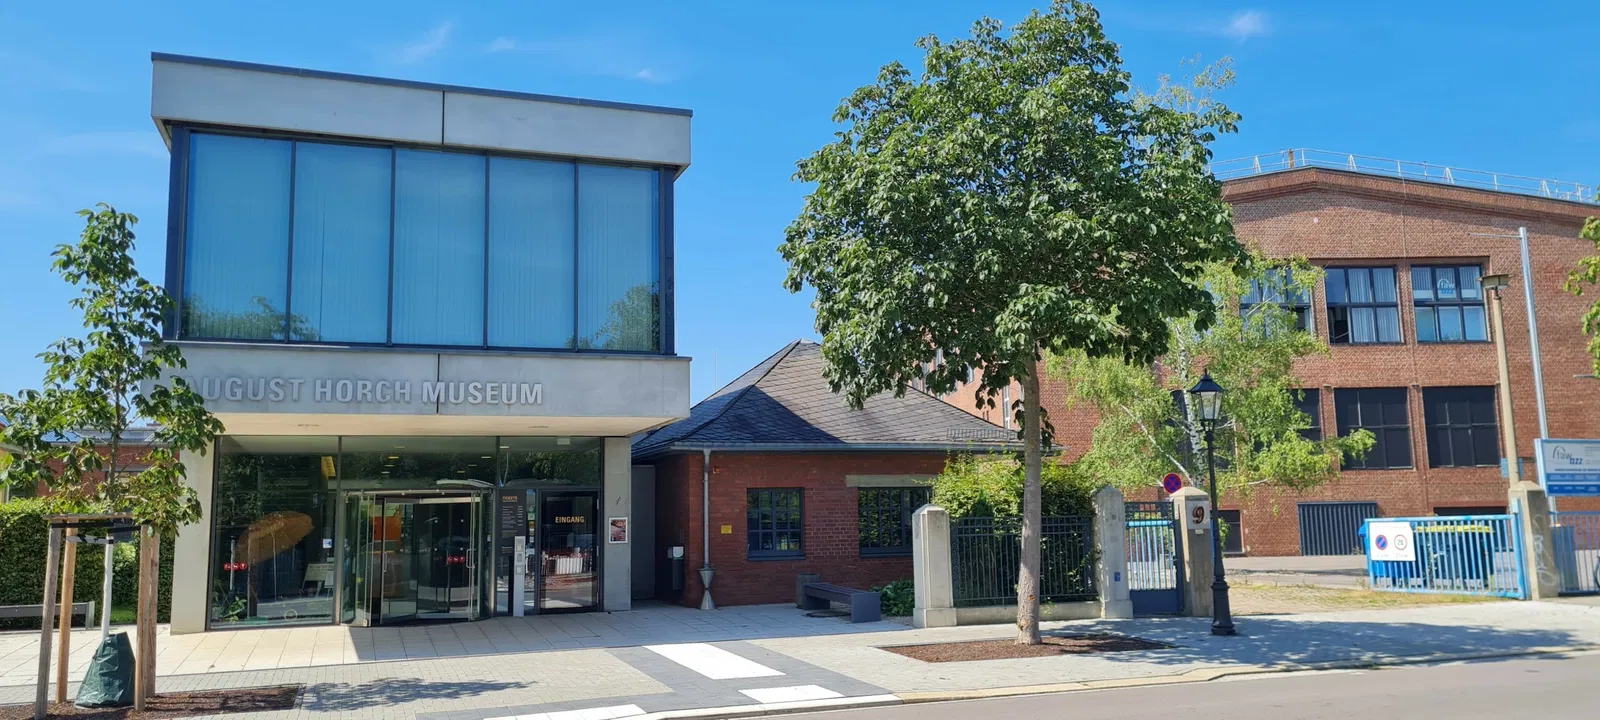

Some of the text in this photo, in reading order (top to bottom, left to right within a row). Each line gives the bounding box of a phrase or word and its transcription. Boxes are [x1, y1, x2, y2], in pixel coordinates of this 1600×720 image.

[315, 379, 411, 403] HORCH
[422, 381, 542, 405] MUSEUM
[1192, 505, 1205, 524] 9
